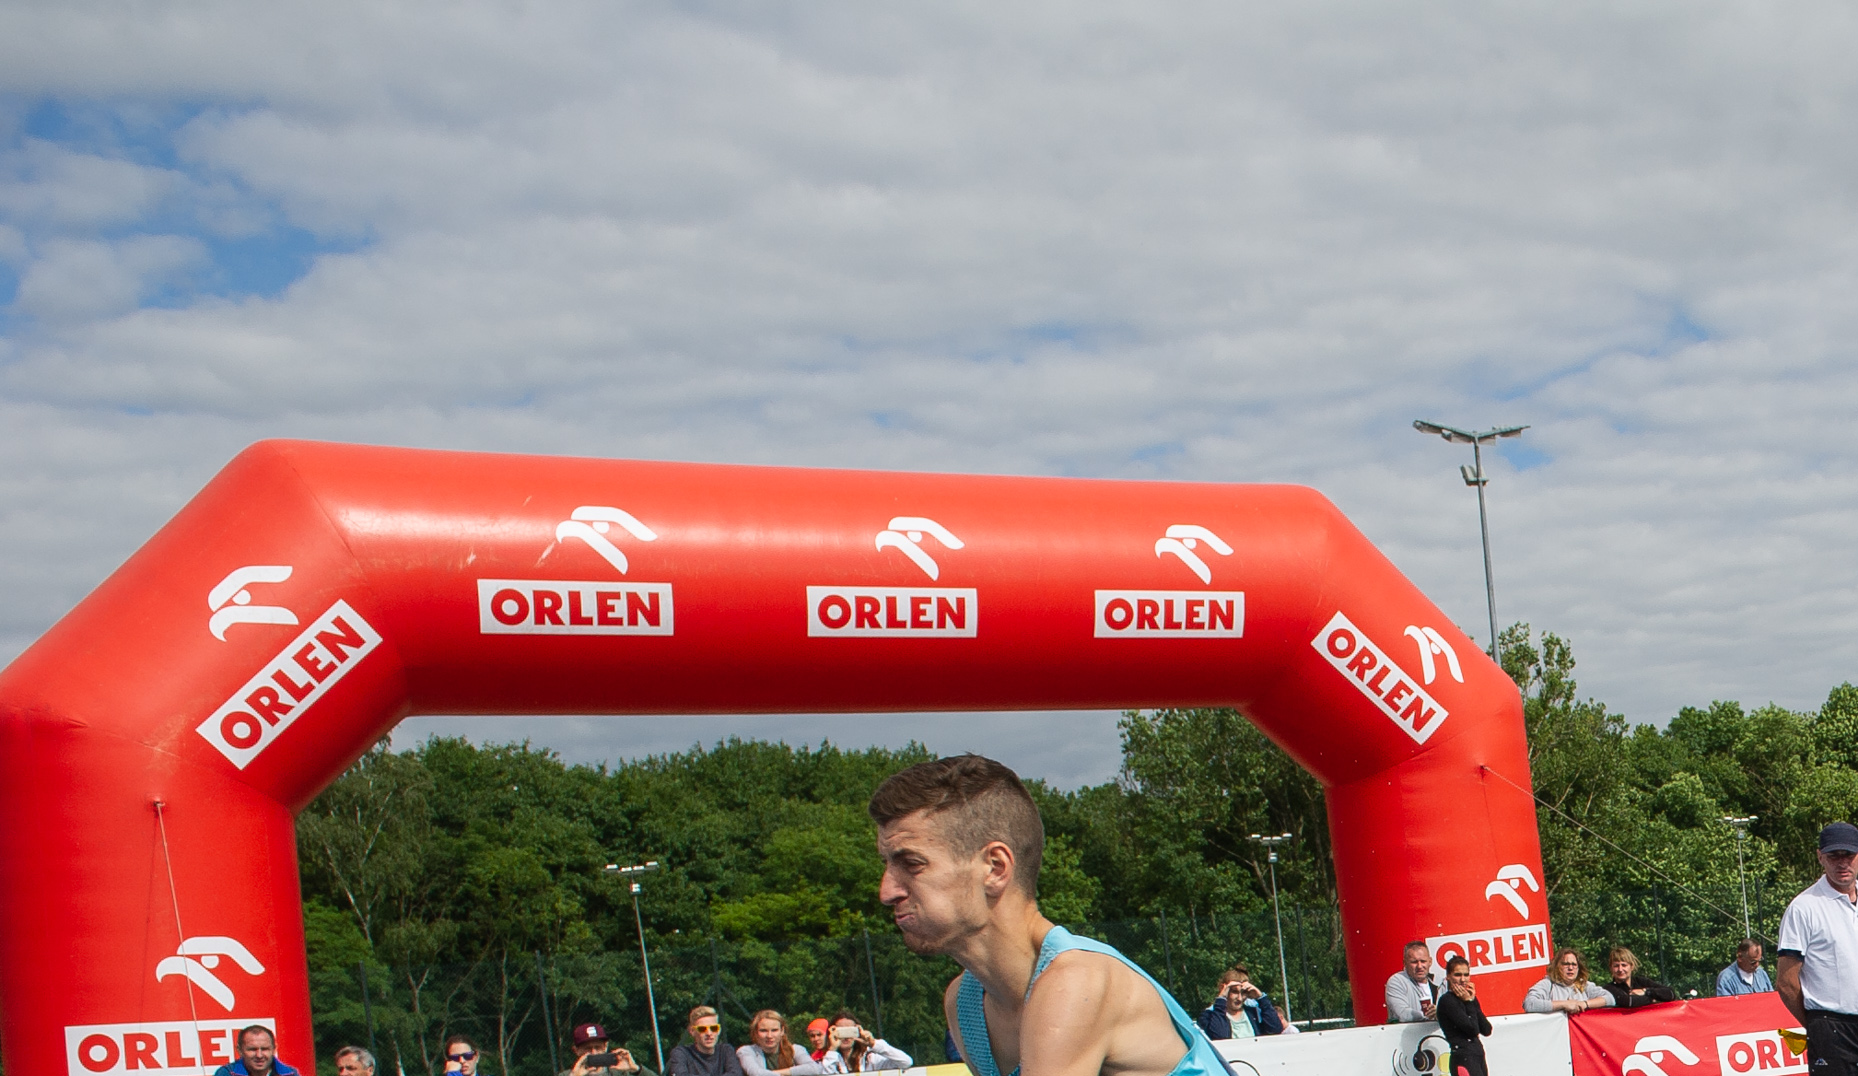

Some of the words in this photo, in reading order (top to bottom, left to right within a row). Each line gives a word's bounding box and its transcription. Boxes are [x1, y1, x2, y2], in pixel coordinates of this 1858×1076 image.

[490, 588, 661, 627] ORLEN
[817, 594, 967, 629] ORLEN
[1103, 598, 1235, 631] ORLEN
[220, 615, 367, 749] ORLEN
[1327, 628, 1437, 733] ORLEN
[1436, 931, 1545, 970] ORLEN
[78, 1028, 243, 1073] ORLE
[1727, 1036, 1809, 1073] ORL
